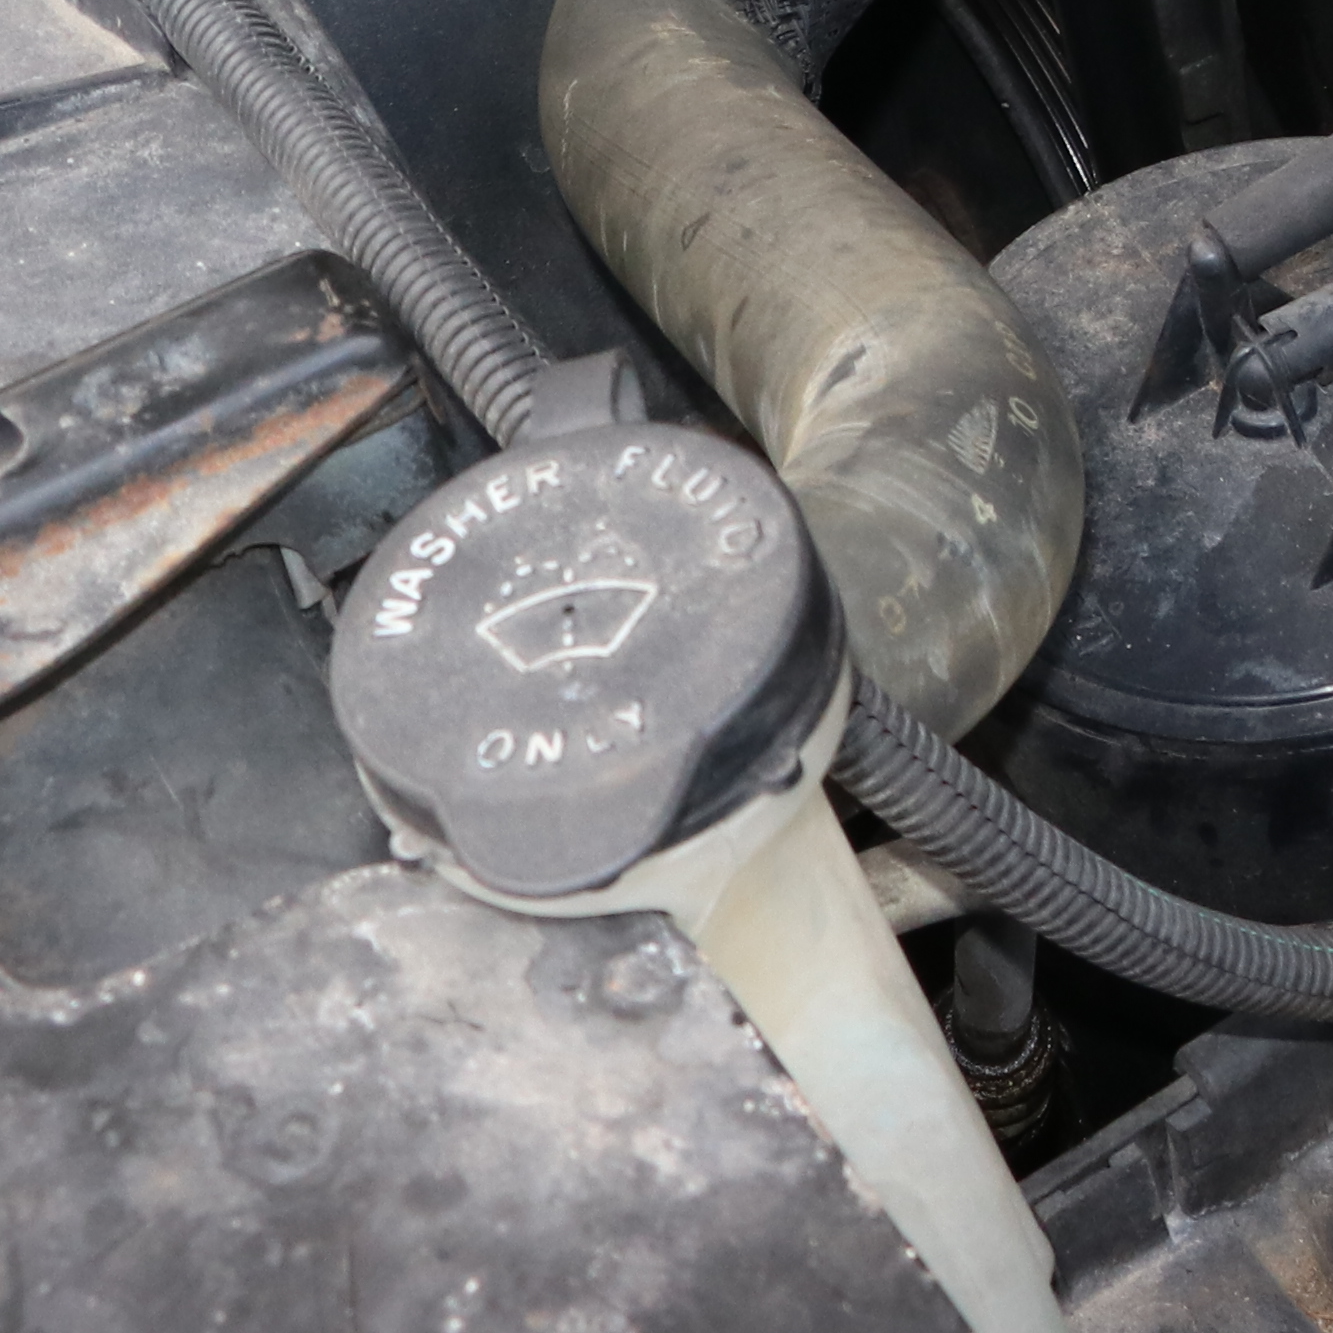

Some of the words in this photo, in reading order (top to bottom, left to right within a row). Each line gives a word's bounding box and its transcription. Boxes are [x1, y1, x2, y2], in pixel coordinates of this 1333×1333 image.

[373, 459, 565, 638] WASHER
[612, 445, 764, 559] FLUID
[476, 700, 643, 769] ONLY
